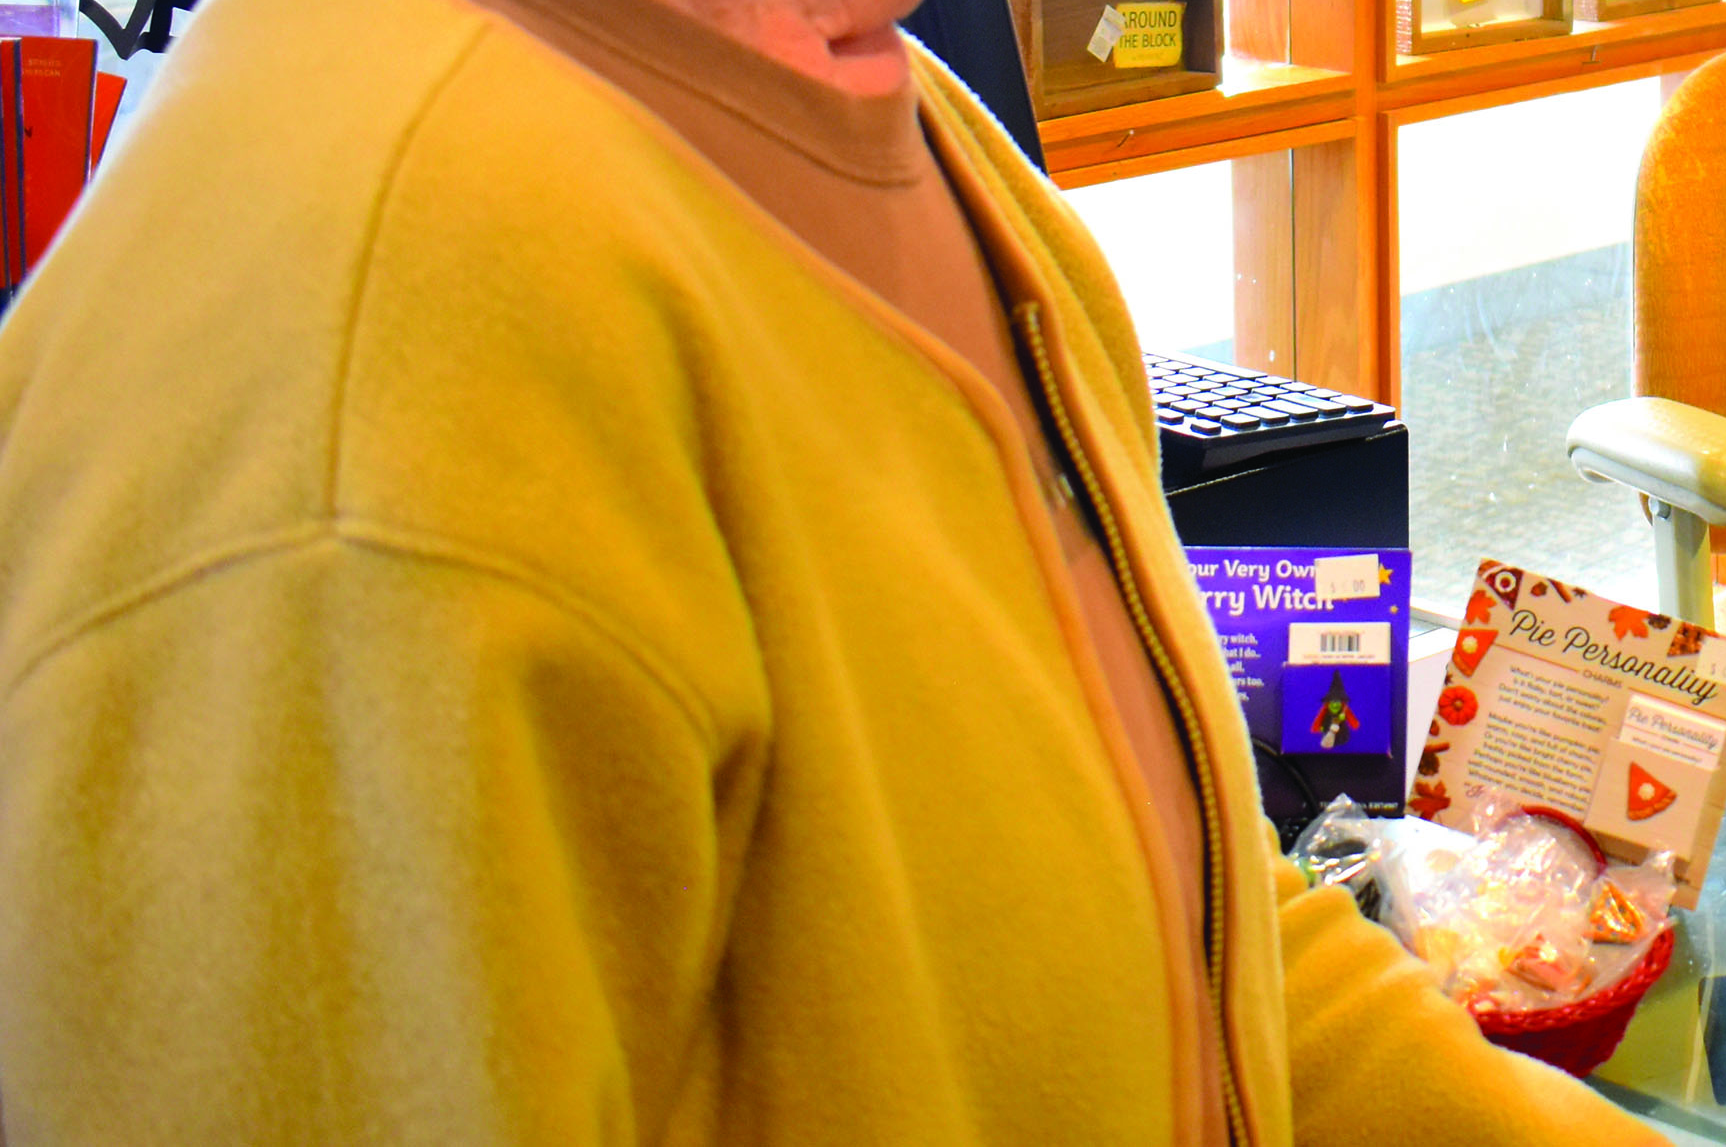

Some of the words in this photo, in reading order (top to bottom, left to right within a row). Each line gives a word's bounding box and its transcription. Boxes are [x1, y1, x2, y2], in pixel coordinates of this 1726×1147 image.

[1119, 34, 1138, 49] THE
[1142, 33, 1177, 48] BLOCK
[1223, 559, 1270, 582] Very
[1509, 609, 1557, 647] Pie
[1562, 626, 1719, 706] Personality
